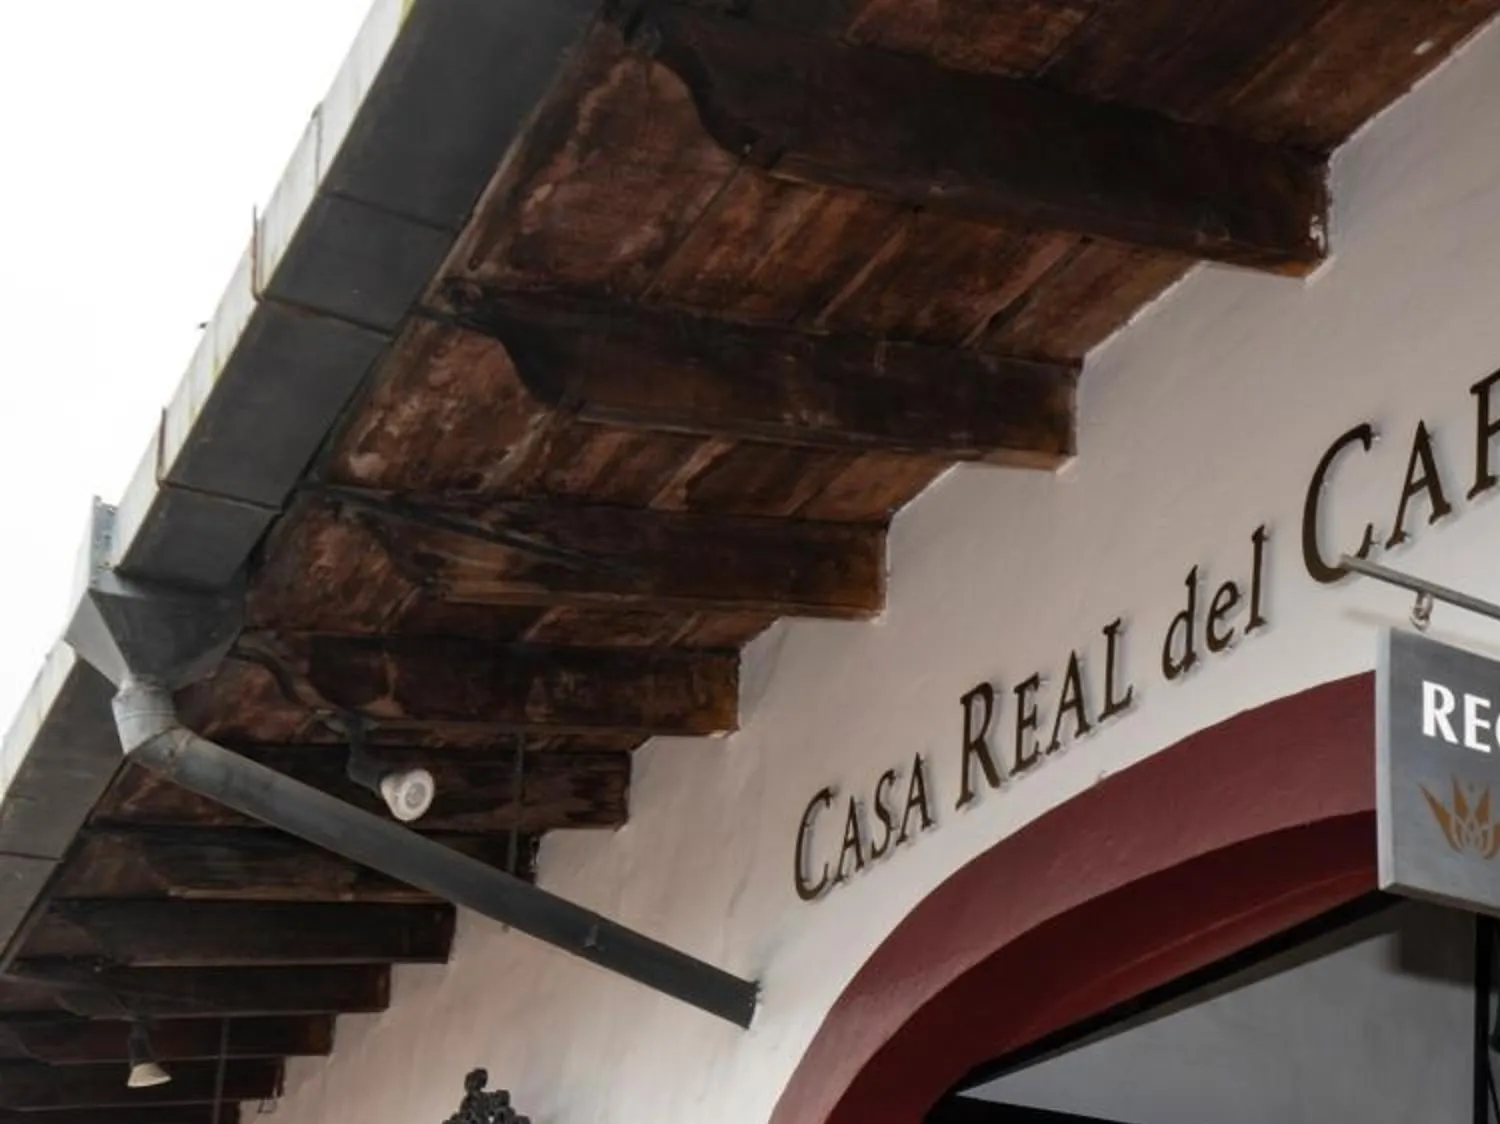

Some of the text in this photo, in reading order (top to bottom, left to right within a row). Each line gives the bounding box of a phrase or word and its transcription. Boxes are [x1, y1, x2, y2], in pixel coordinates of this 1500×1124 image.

[793, 752, 935, 901] CASA
[954, 618, 1134, 811] REAL
[1161, 525, 1270, 681] del
